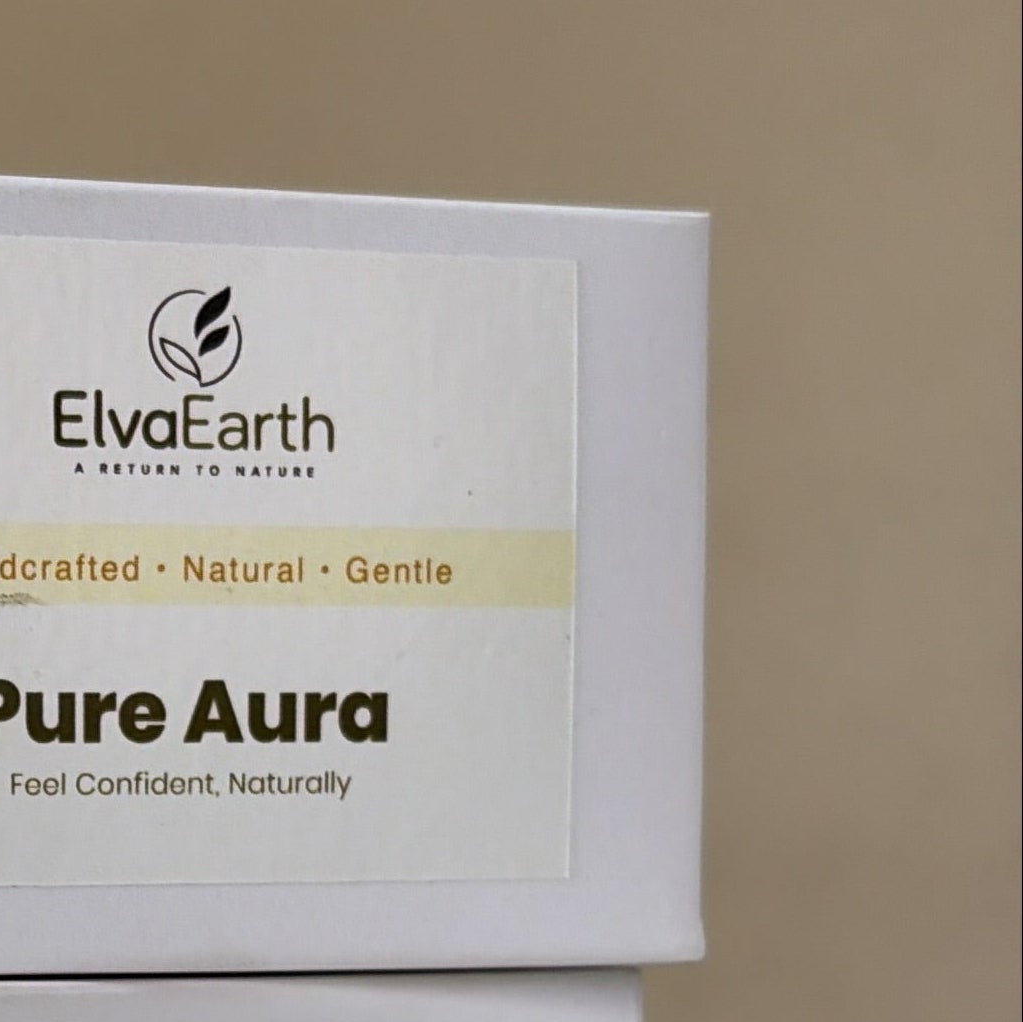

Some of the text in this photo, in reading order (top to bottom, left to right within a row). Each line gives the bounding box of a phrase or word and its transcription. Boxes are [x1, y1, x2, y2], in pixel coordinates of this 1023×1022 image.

[52, 389, 336, 453] ElvaEarth
[74, 463, 316, 478] A RETURN TO NATURE
[183, 555, 304, 584] Natural
[346, 556, 453, 585] Gentle
[183, 679, 389, 744] Aura
[10, 770, 352, 800] Feel Confident, Naturally
